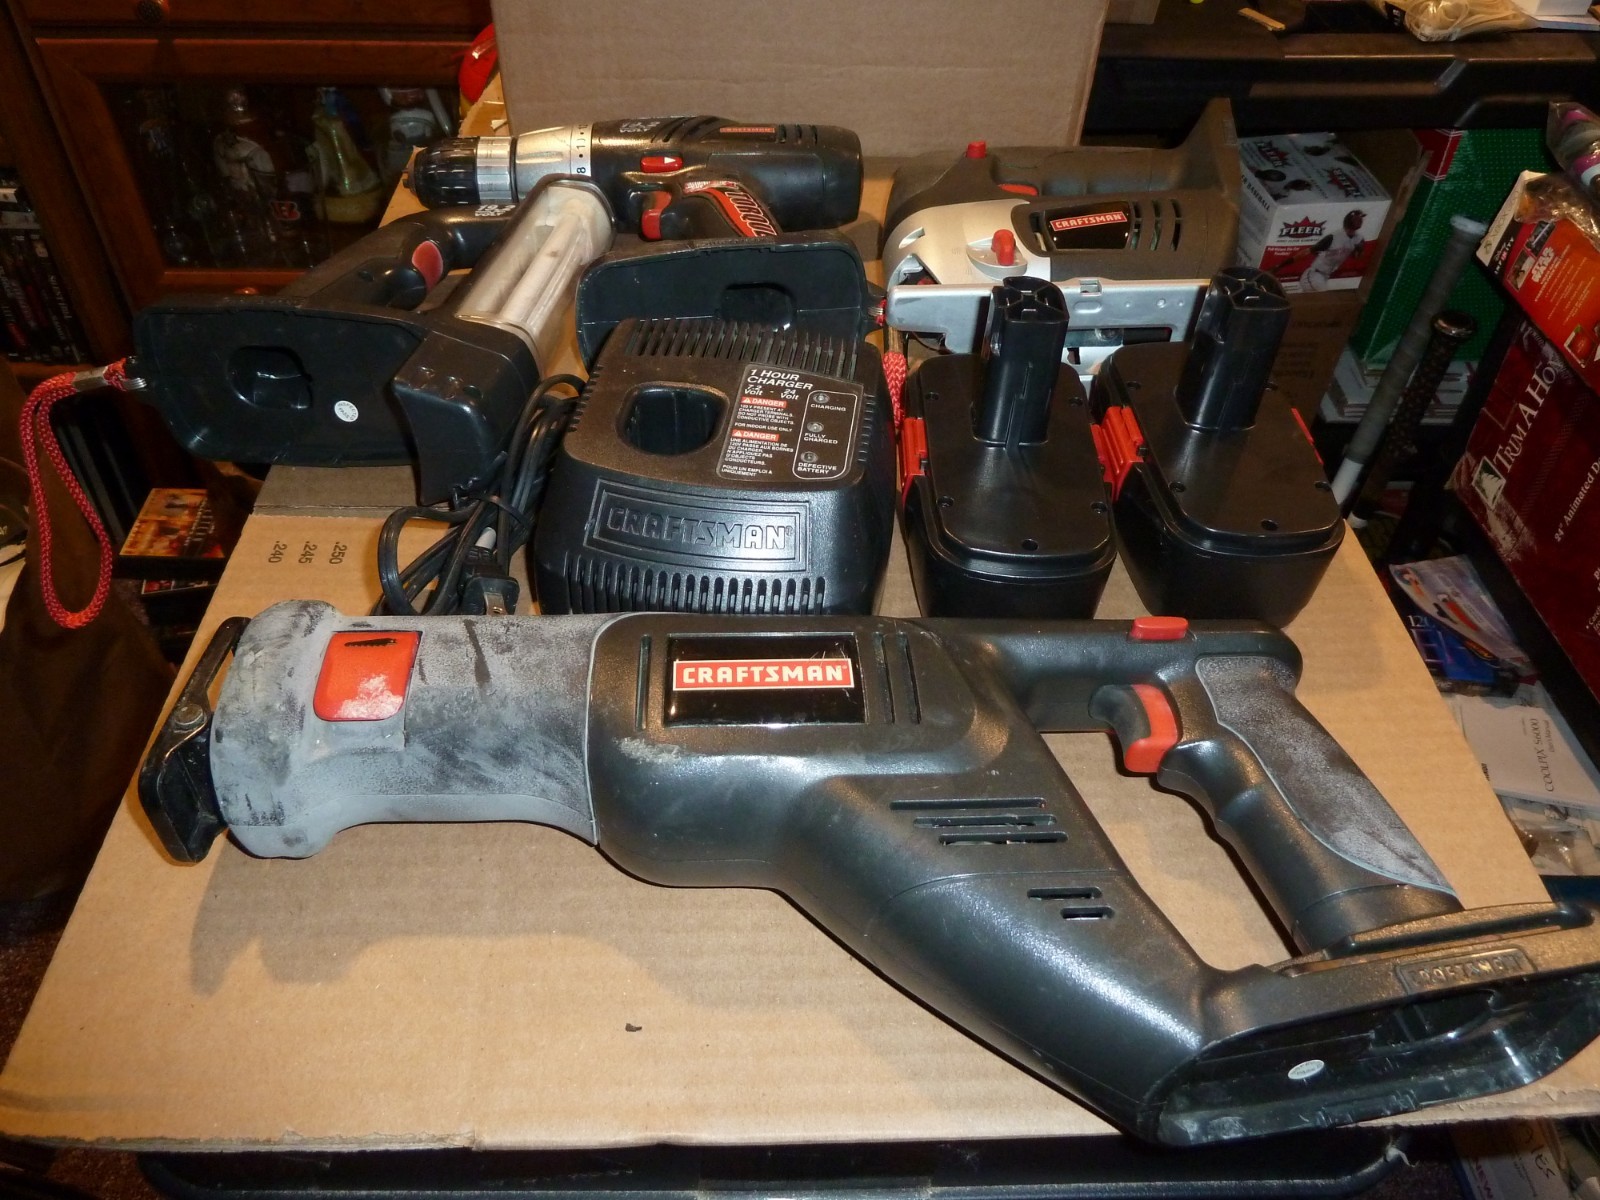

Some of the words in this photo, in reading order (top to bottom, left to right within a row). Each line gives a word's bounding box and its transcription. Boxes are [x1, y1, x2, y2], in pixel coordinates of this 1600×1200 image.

[1055, 213, 1123, 229] CRAFTSMAN
[1280, 225, 1323, 236] FLEER
[748, 376, 813, 390] CHARGER
[761, 370, 799, 380] HOUR
[752, 398, 785, 406] DANGER
[743, 432, 777, 440] DANGER
[1493, 424, 1527, 472] TRIM
[1563, 471, 1595, 527] Animated
[267, 541, 288, 563] .240
[298, 541, 318, 564] .245
[329, 541, 348, 565] .250
[682, 665, 846, 684] CRAFTSMAN
[1535, 748, 1554, 791] COOLPIX
